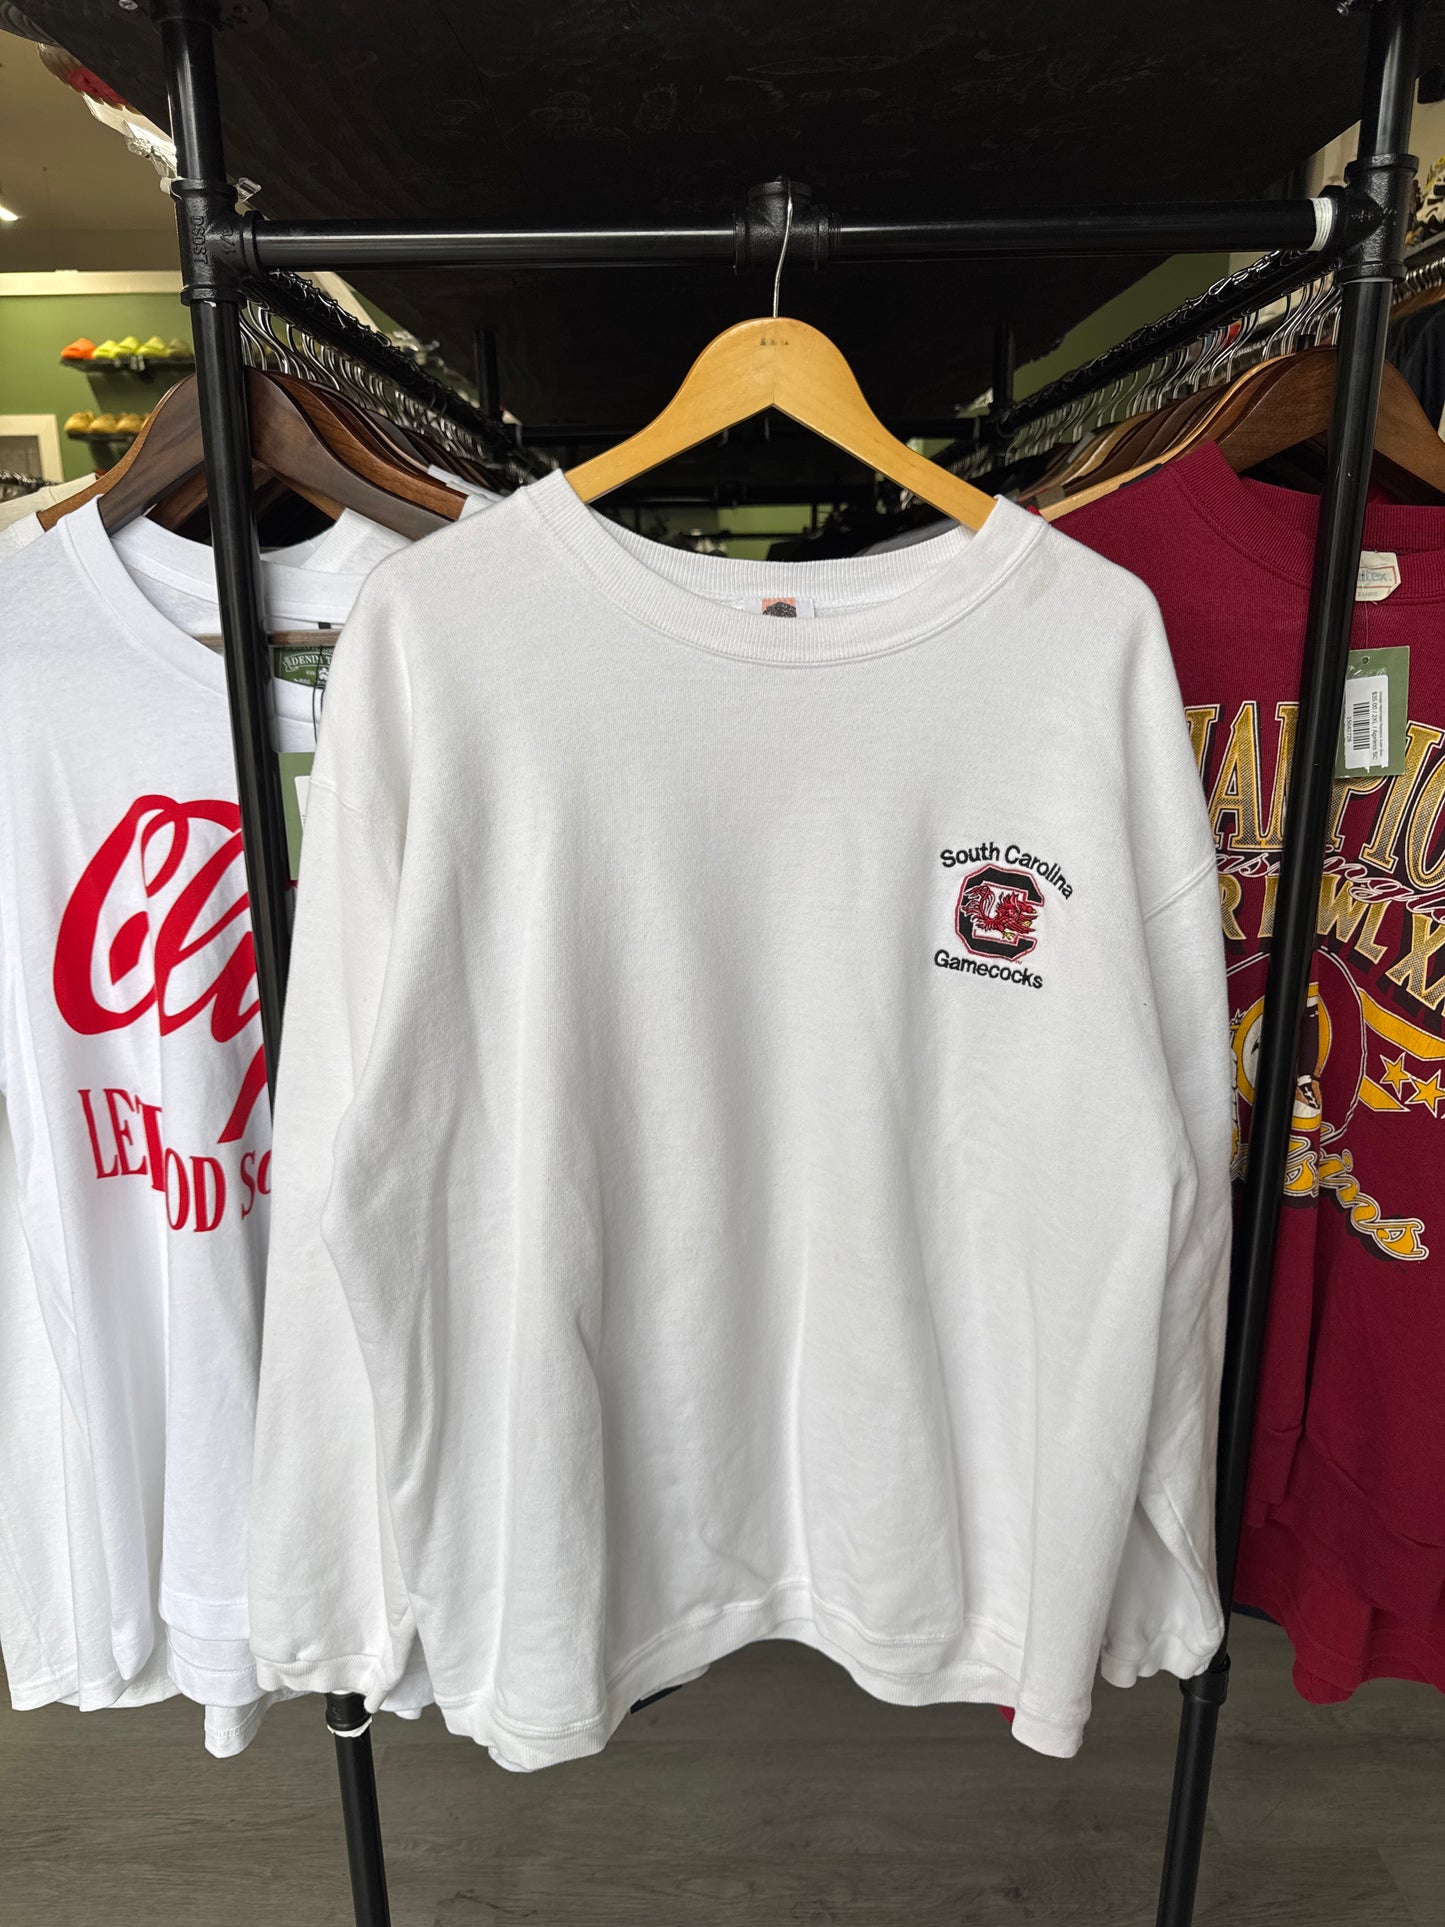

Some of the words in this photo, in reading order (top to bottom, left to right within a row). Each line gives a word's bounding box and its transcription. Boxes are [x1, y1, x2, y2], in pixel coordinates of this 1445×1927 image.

[940, 842, 1000, 867] South
[1004, 844, 1074, 900] Carolina
[934, 949, 1043, 989] Gamecocks
[165, 1147, 227, 1233] OD
